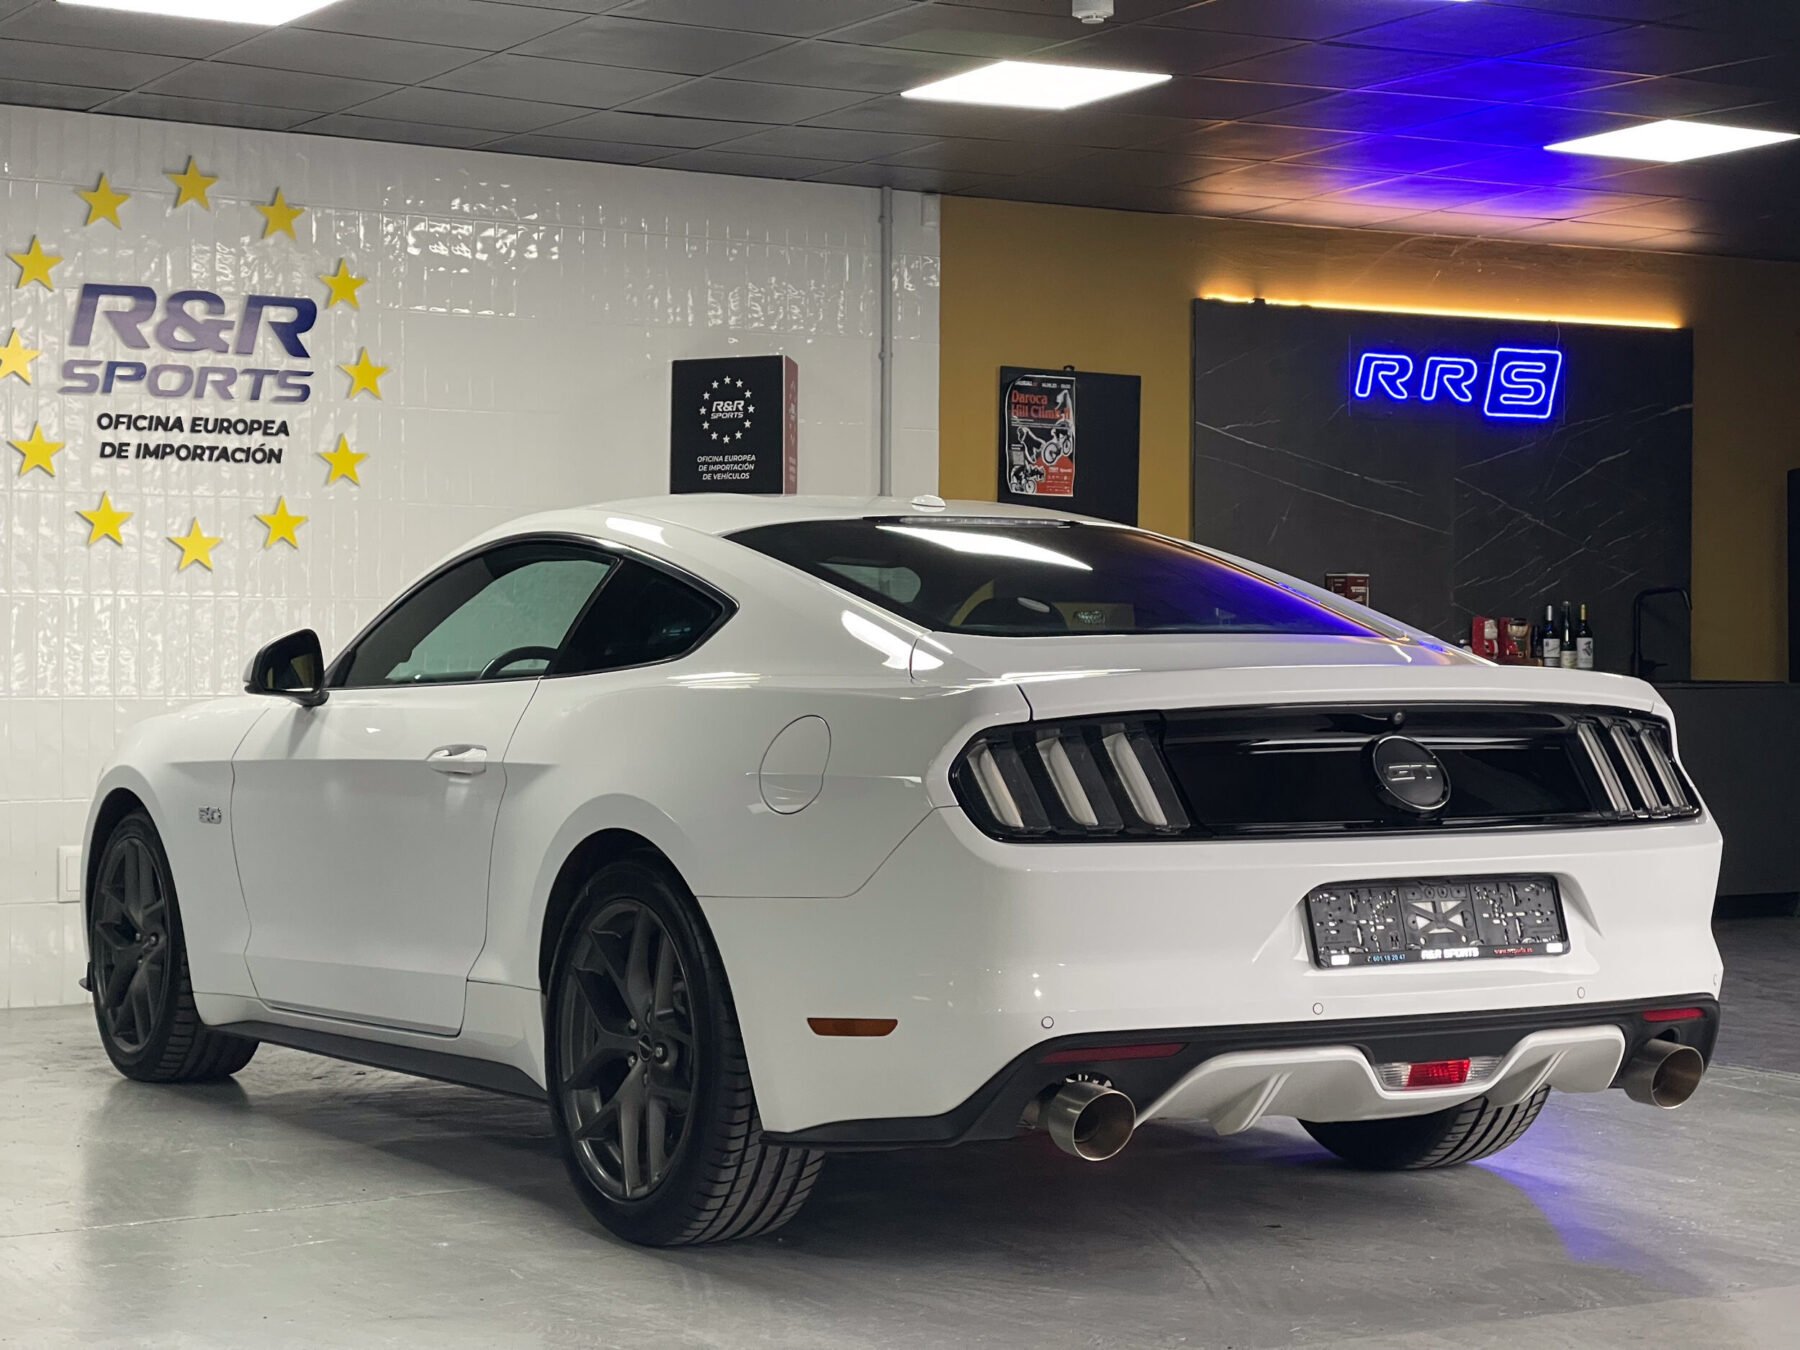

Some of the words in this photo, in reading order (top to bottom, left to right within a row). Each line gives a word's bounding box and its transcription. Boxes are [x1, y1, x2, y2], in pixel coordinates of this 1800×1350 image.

[69, 283, 317, 358] R&R
[58, 359, 315, 403] SPORTS
[1011, 390, 1048, 404] Daroca
[712, 400, 744, 412] R&R
[96, 412, 184, 433] OFICINA
[190, 417, 290, 436] EUROPEA
[100, 442, 129, 459] DE
[136, 443, 283, 464] IMPORTACIÓN
[697, 455, 723, 463] OFICINA
[724, 454, 756, 462] EUROPEA
[698, 464, 708, 472] DE
[708, 462, 754, 471] IMPORTACIÓN
[713, 471, 750, 480] VEHÍCULOS
[1443, 947, 1479, 959] SPORTS
